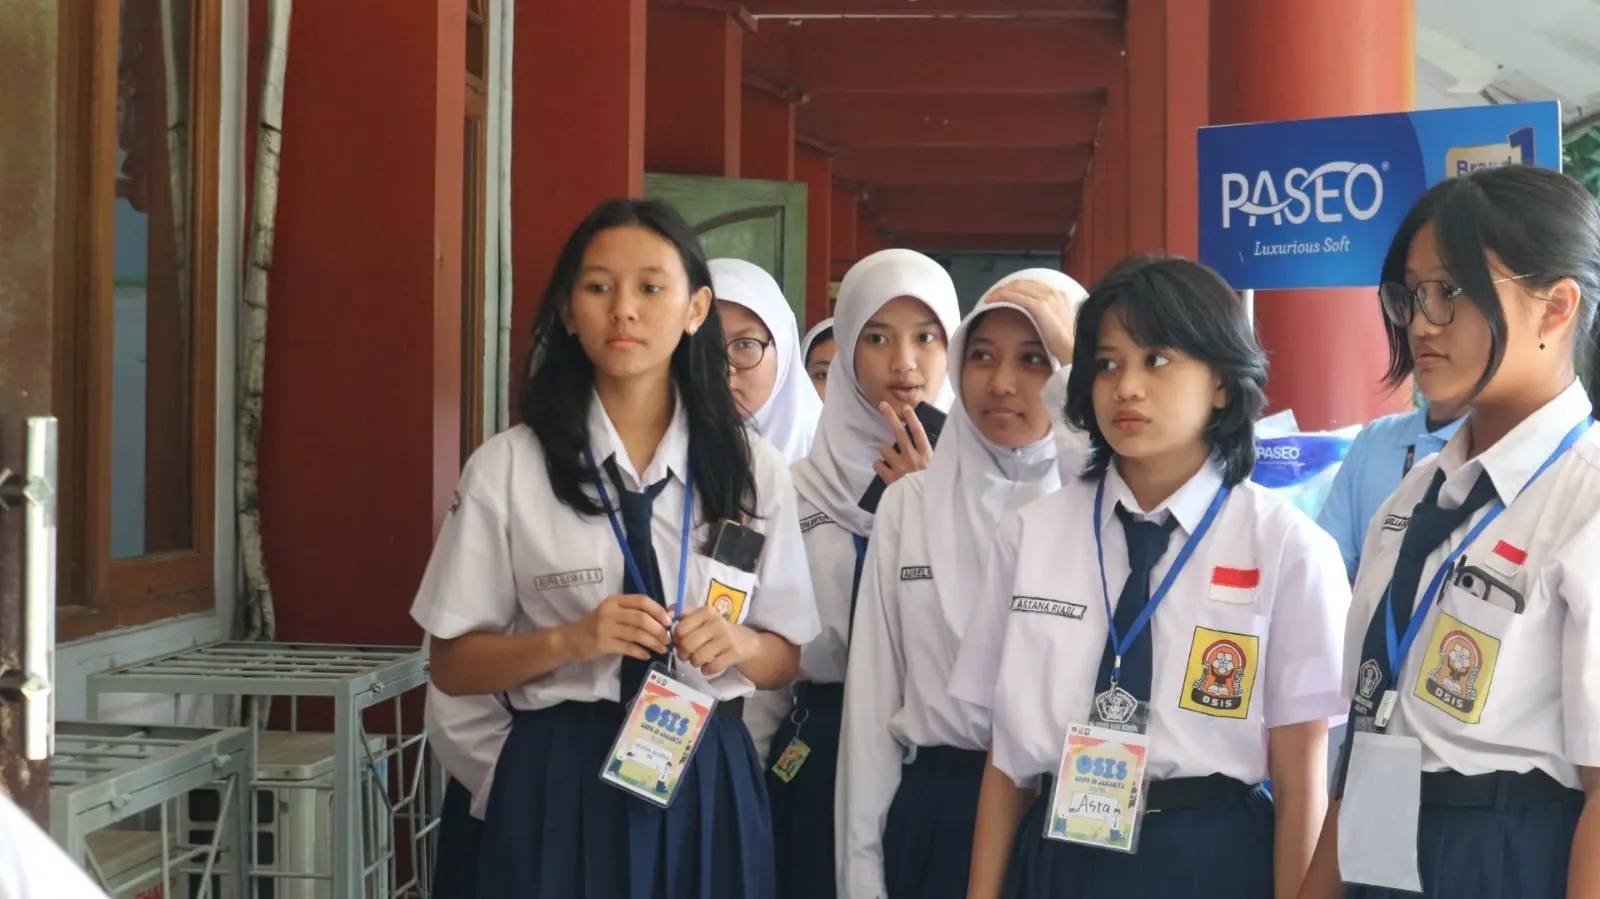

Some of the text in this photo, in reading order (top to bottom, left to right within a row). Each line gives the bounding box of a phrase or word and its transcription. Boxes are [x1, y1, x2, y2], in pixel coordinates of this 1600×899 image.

[1222, 161, 1384, 228] PASEO
[1254, 236, 1352, 256] Luxurious Soft
[1256, 446, 1300, 460] PASEO
[1202, 694, 1233, 708] OSIS
[1435, 687, 1464, 709] OSIS
[645, 703, 690, 736] OSIS
[1076, 754, 1128, 780] OSIS
